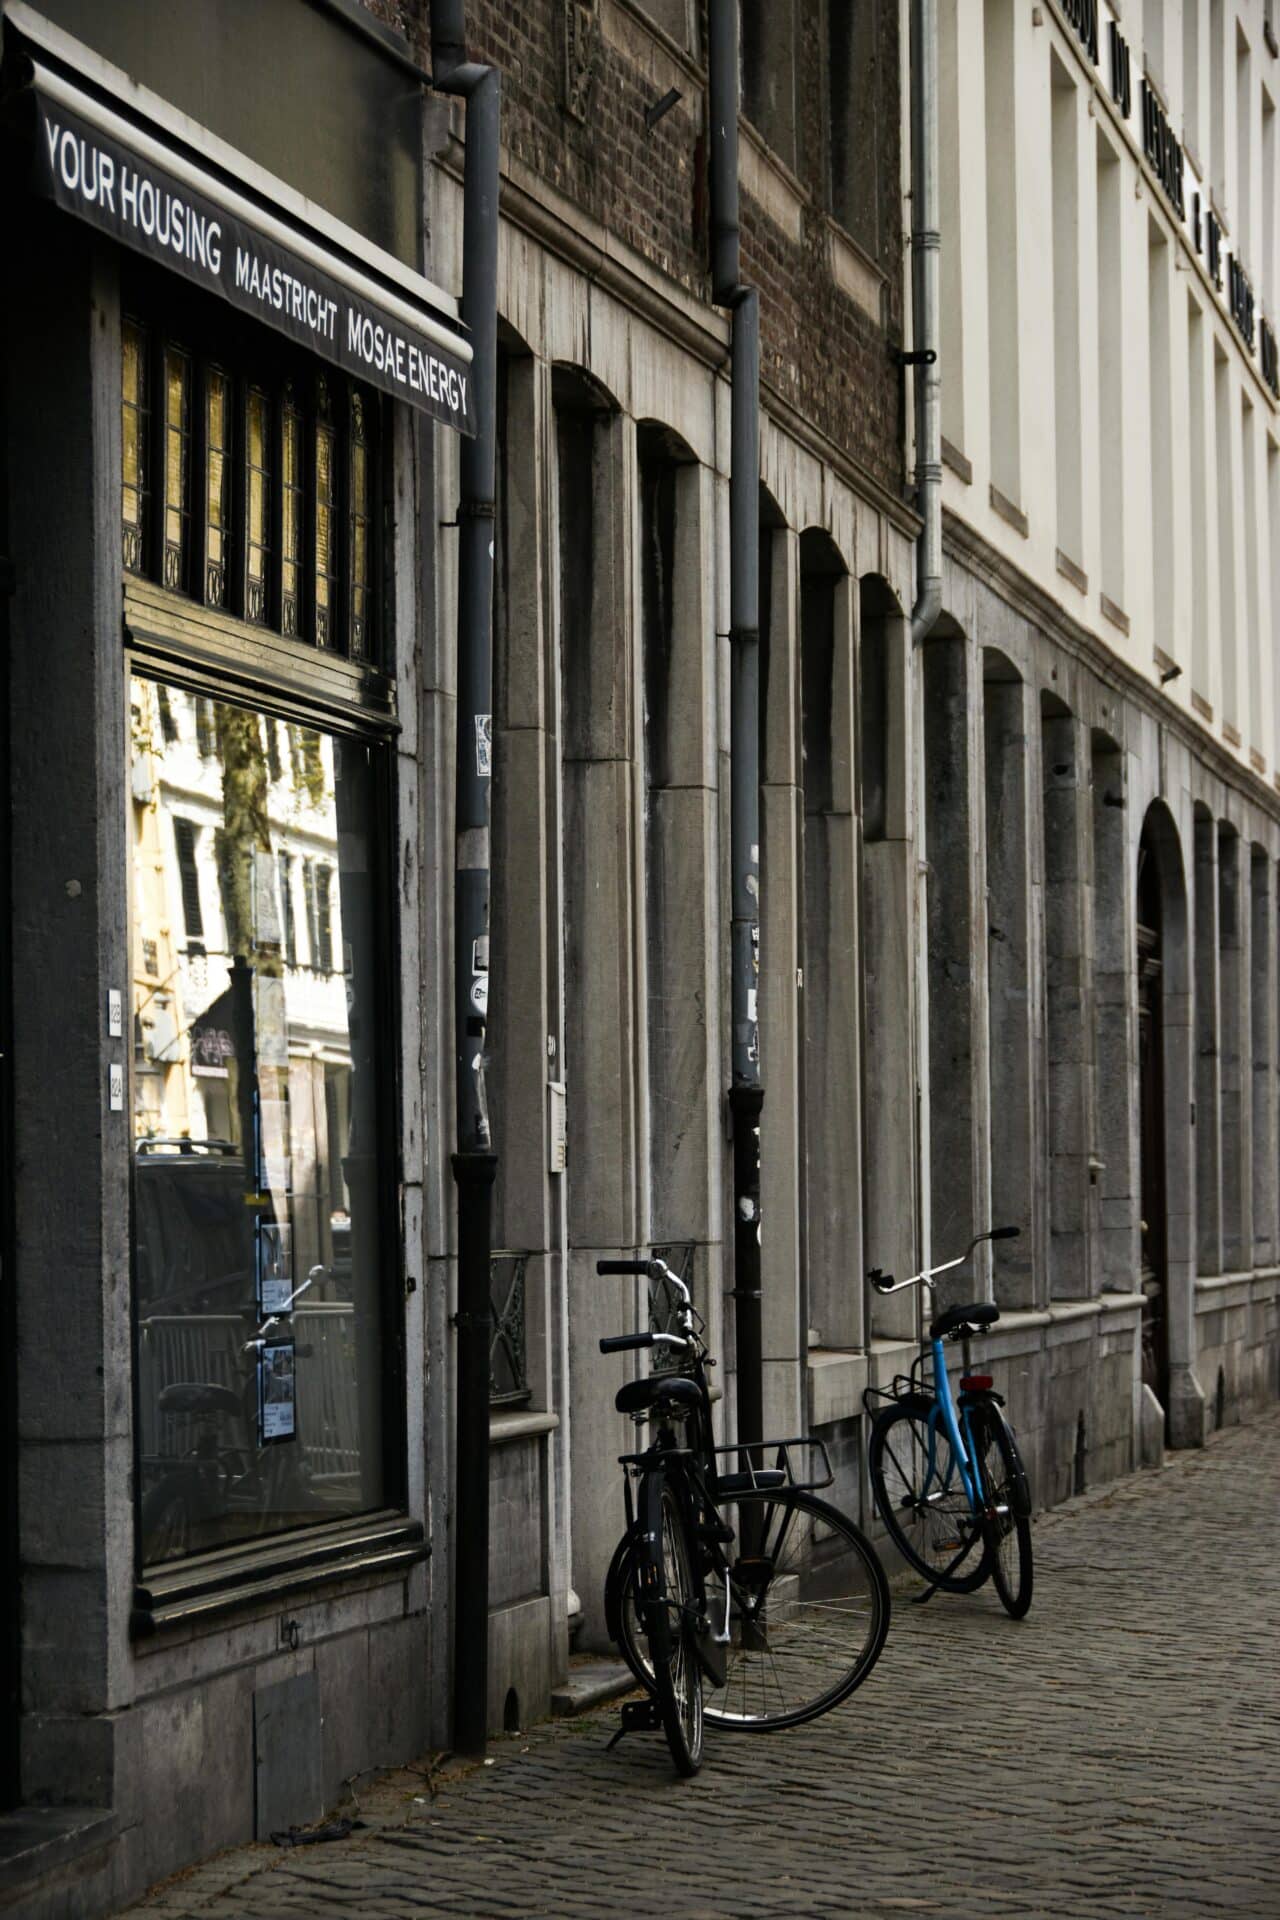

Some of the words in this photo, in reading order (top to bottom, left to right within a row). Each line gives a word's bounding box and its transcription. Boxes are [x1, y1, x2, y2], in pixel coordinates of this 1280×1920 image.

[45, 117, 115, 214] YOUR
[121, 166, 222, 275] HOUSING
[235, 246, 338, 340] MAASTRICHT
[348, 308, 407, 384] MOSAE
[408, 346, 467, 416] ENERGY
